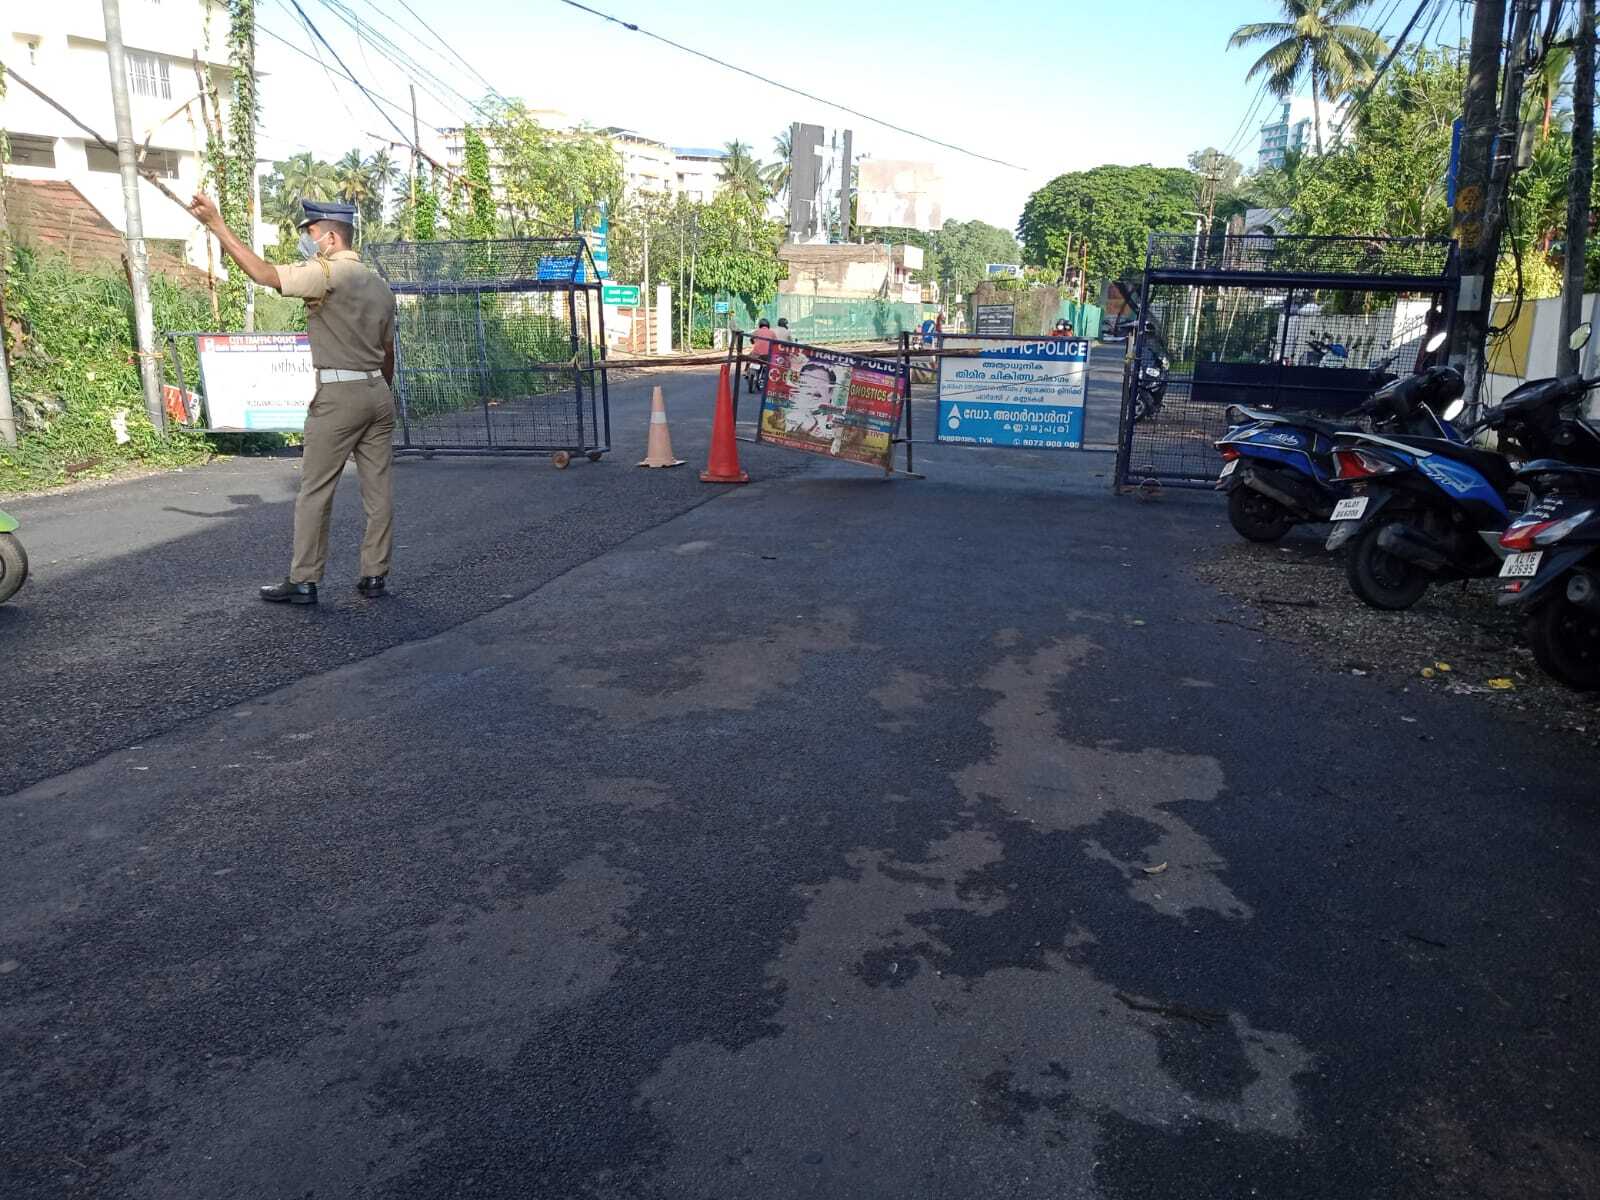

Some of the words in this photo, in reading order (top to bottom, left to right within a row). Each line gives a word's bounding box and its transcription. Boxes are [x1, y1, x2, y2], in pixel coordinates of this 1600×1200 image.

[245, 336, 272, 344] TRAFFIC
[273, 336, 296, 344] POLICE
[1037, 341, 1088, 356] POLICE
